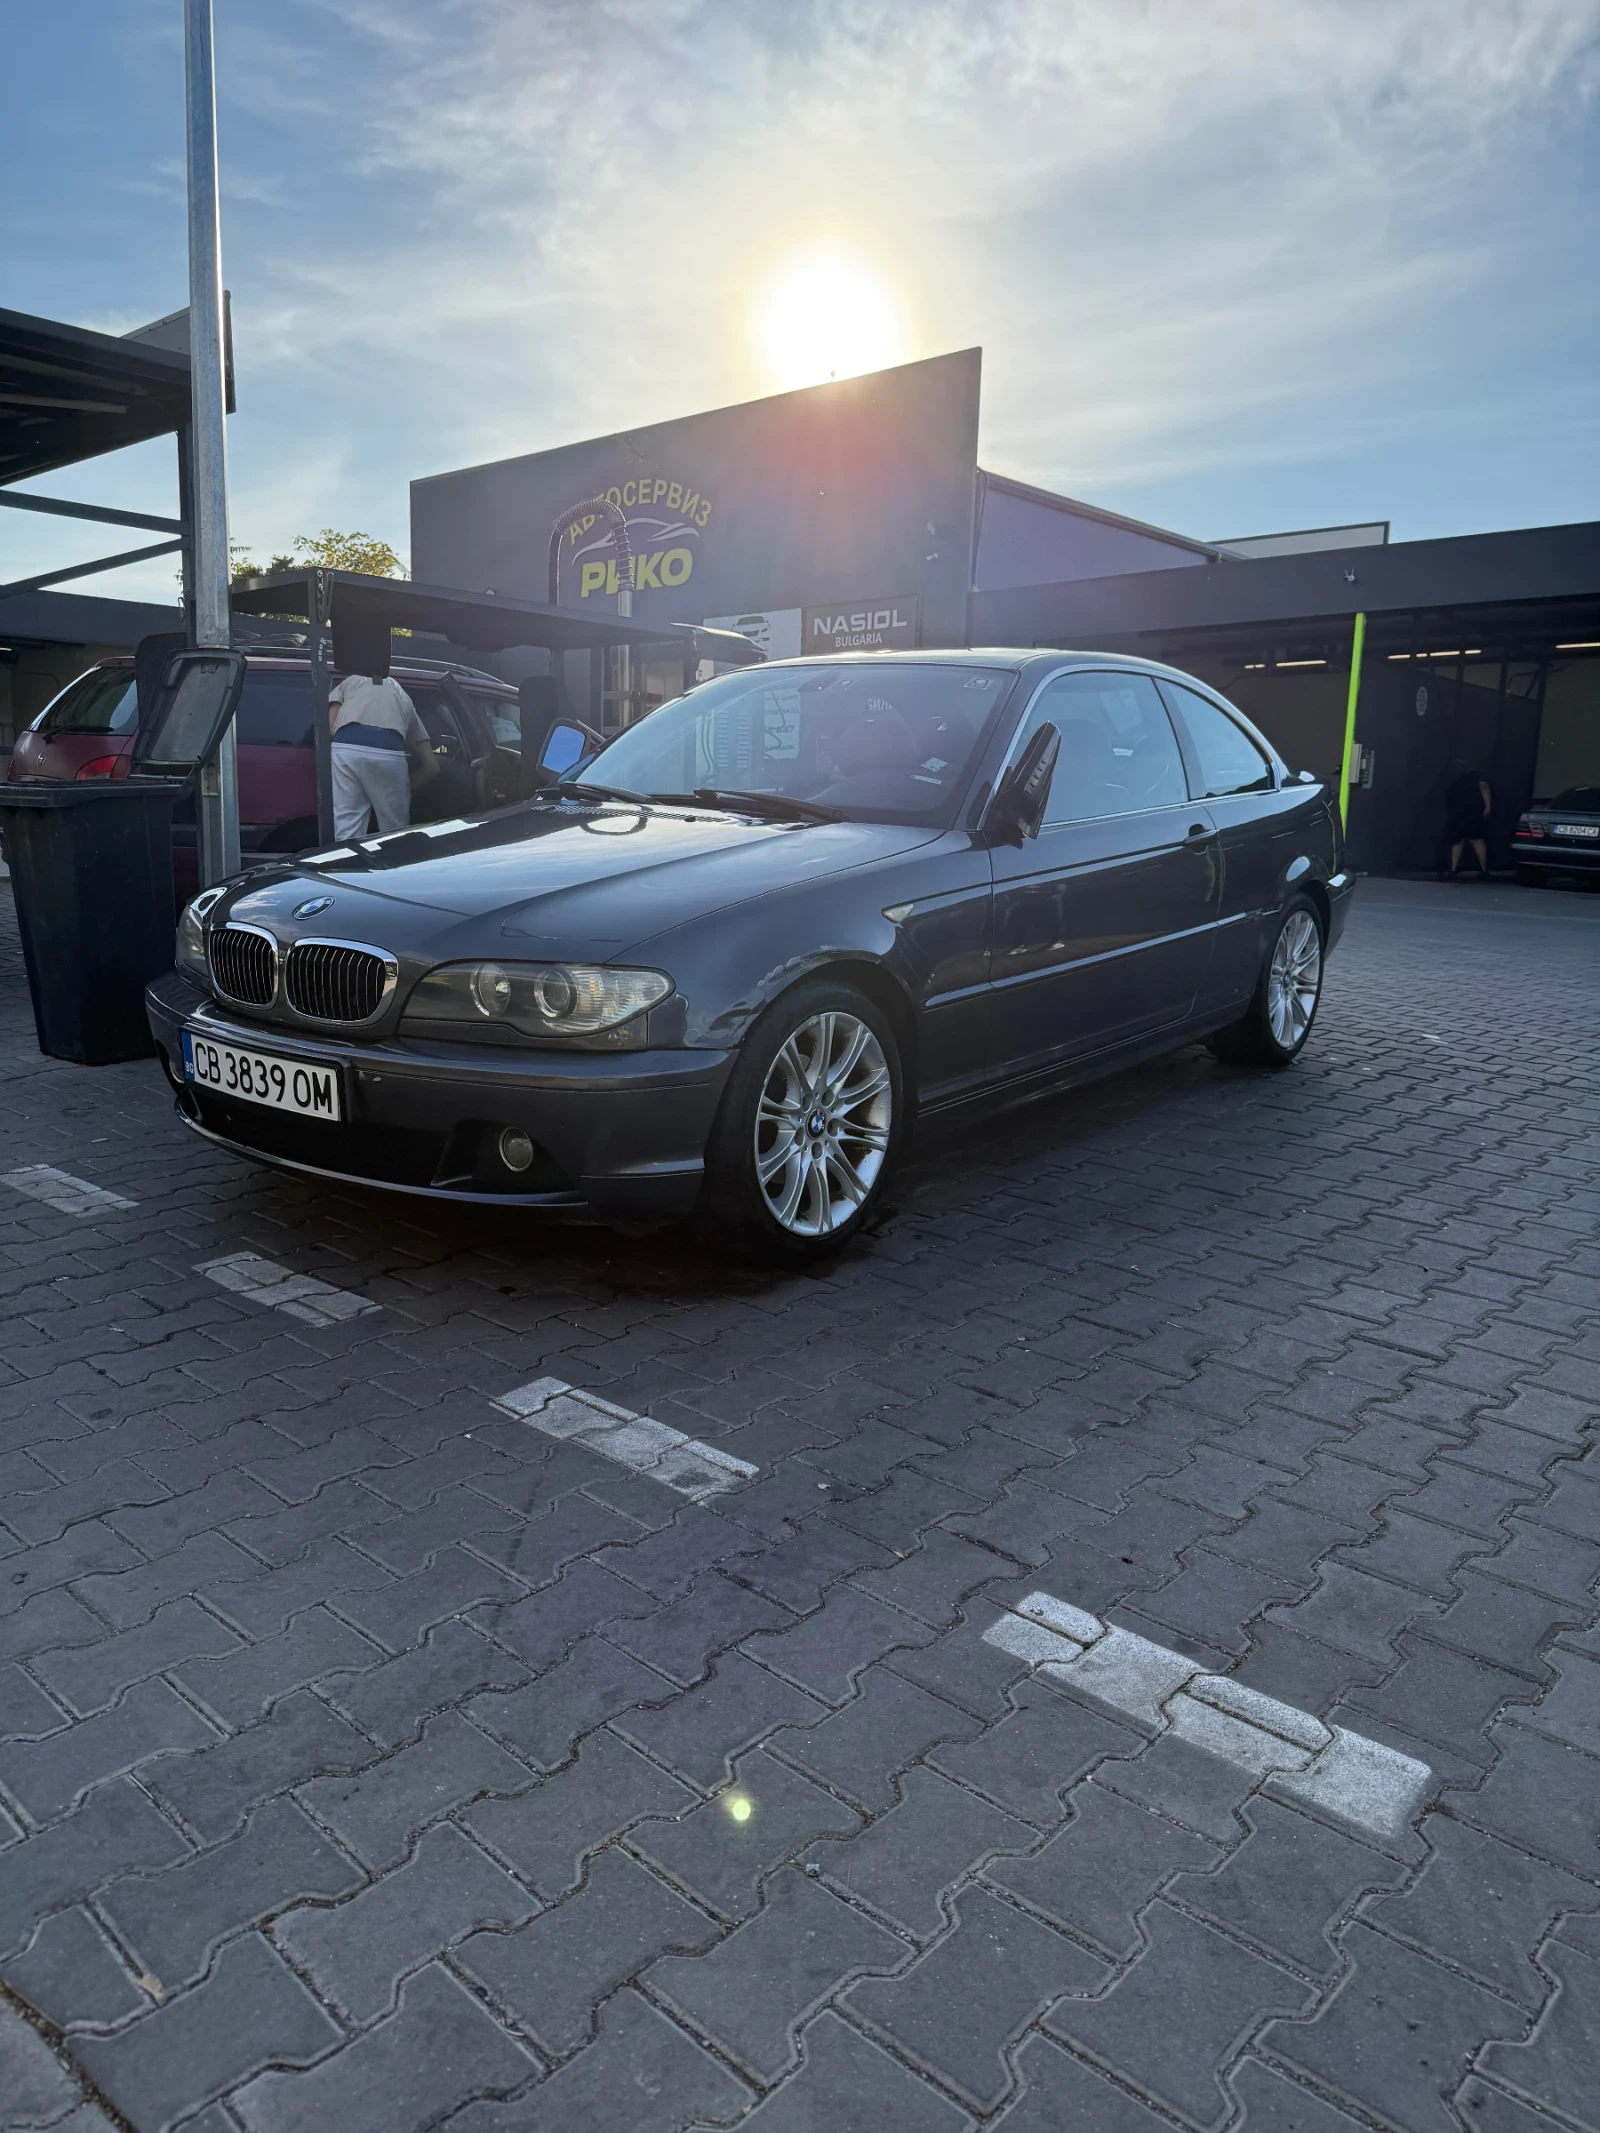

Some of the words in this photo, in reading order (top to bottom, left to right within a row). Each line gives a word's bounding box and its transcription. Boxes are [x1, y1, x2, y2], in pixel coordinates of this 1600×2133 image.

[569, 478, 712, 546] АОСЕРВИЗ
[813, 609, 908, 636] NASIOL
[835, 632, 883, 648] BULGARIA
[185, 1060, 194, 1074] BG
[195, 1041, 221, 1084] CB
[225, 1051, 286, 1102] 3839
[293, 1068, 333, 1114] OM
